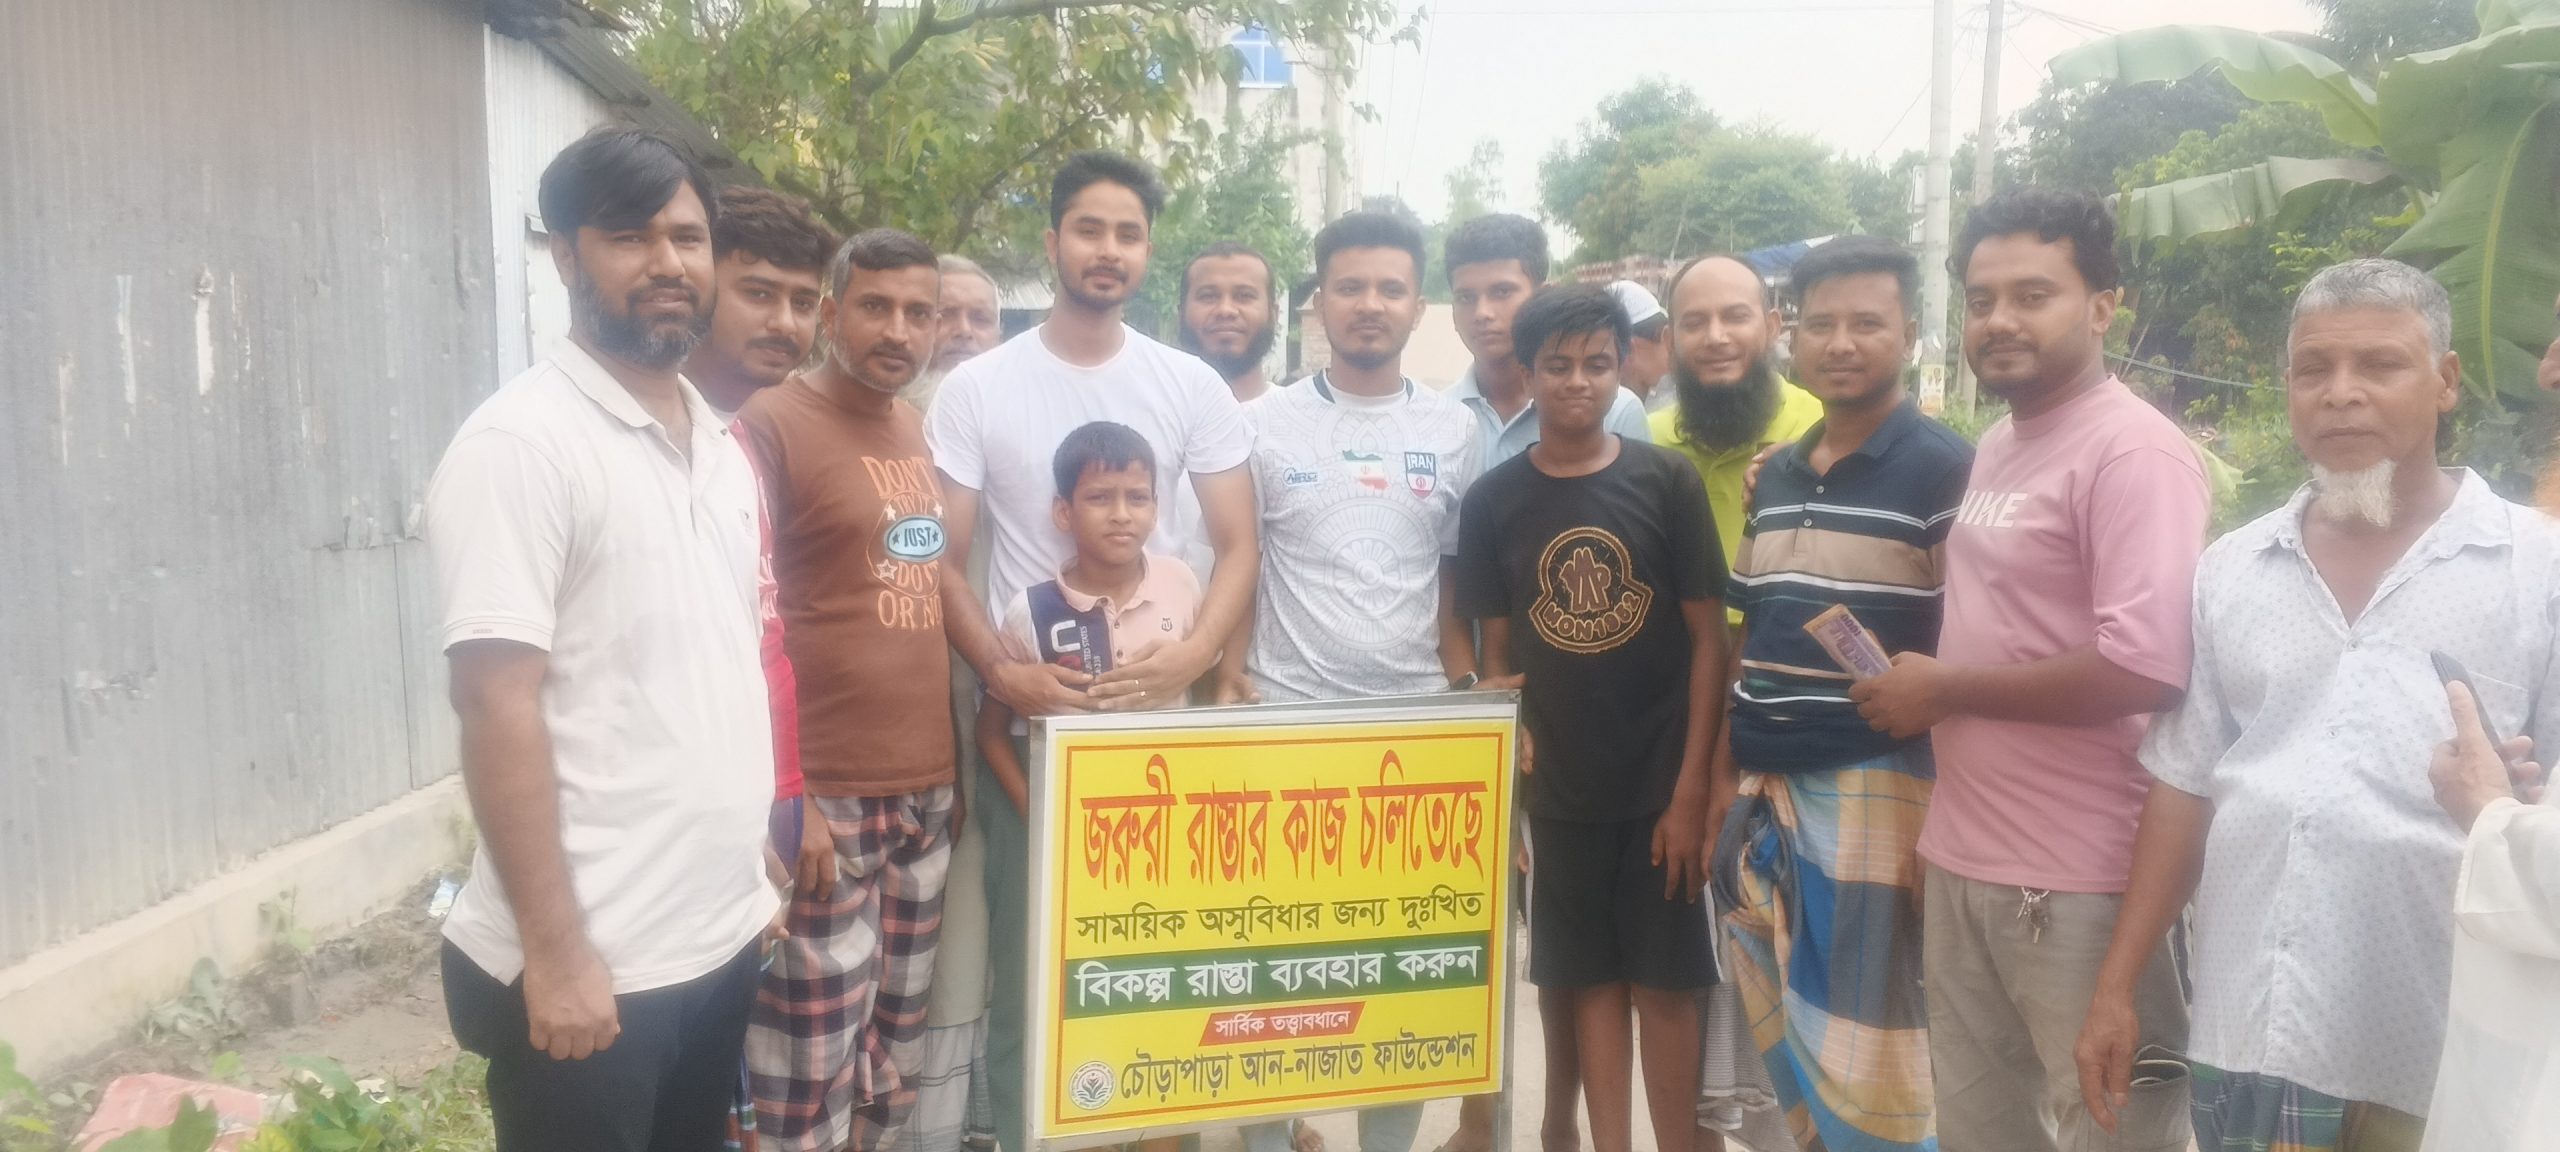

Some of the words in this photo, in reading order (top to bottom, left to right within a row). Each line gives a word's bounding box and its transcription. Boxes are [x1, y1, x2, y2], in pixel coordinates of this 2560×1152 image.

[1407, 453, 1434, 472] IRAN
[1957, 489, 2028, 529] NIKE
[903, 526, 932, 548] JUST
[878, 590, 916, 631] OR
[1080, 625, 1090, 647] STATES
[1080, 753, 1178, 890] জরুরী
[1185, 779, 1273, 887] রাস্তার
[1280, 777, 1350, 881] কাজ
[1357, 749, 1488, 882] চলিতেছে
[1074, 901, 1189, 944] সাময়িক
[1196, 895, 1323, 942] অসুবিধার
[1332, 898, 1389, 927] জন্য
[1398, 884, 1485, 930] দুঃখিত
[1073, 961, 1176, 1007] বিকল্প
[1184, 958, 1259, 998] রাস্তা
[1267, 952, 1386, 992] ব্যবহার
[1394, 945, 1482, 981] করুন
[1215, 1012, 1266, 1037] সার্বিক
[1270, 1010, 1351, 1037] তত্ত্বাবধানে
[1121, 1047, 1233, 1103] চৌড়াপাড়া
[1239, 1042, 1366, 1087] আন-নাজাত
[1372, 1027, 1477, 1076] ফাউন্ডেশন
